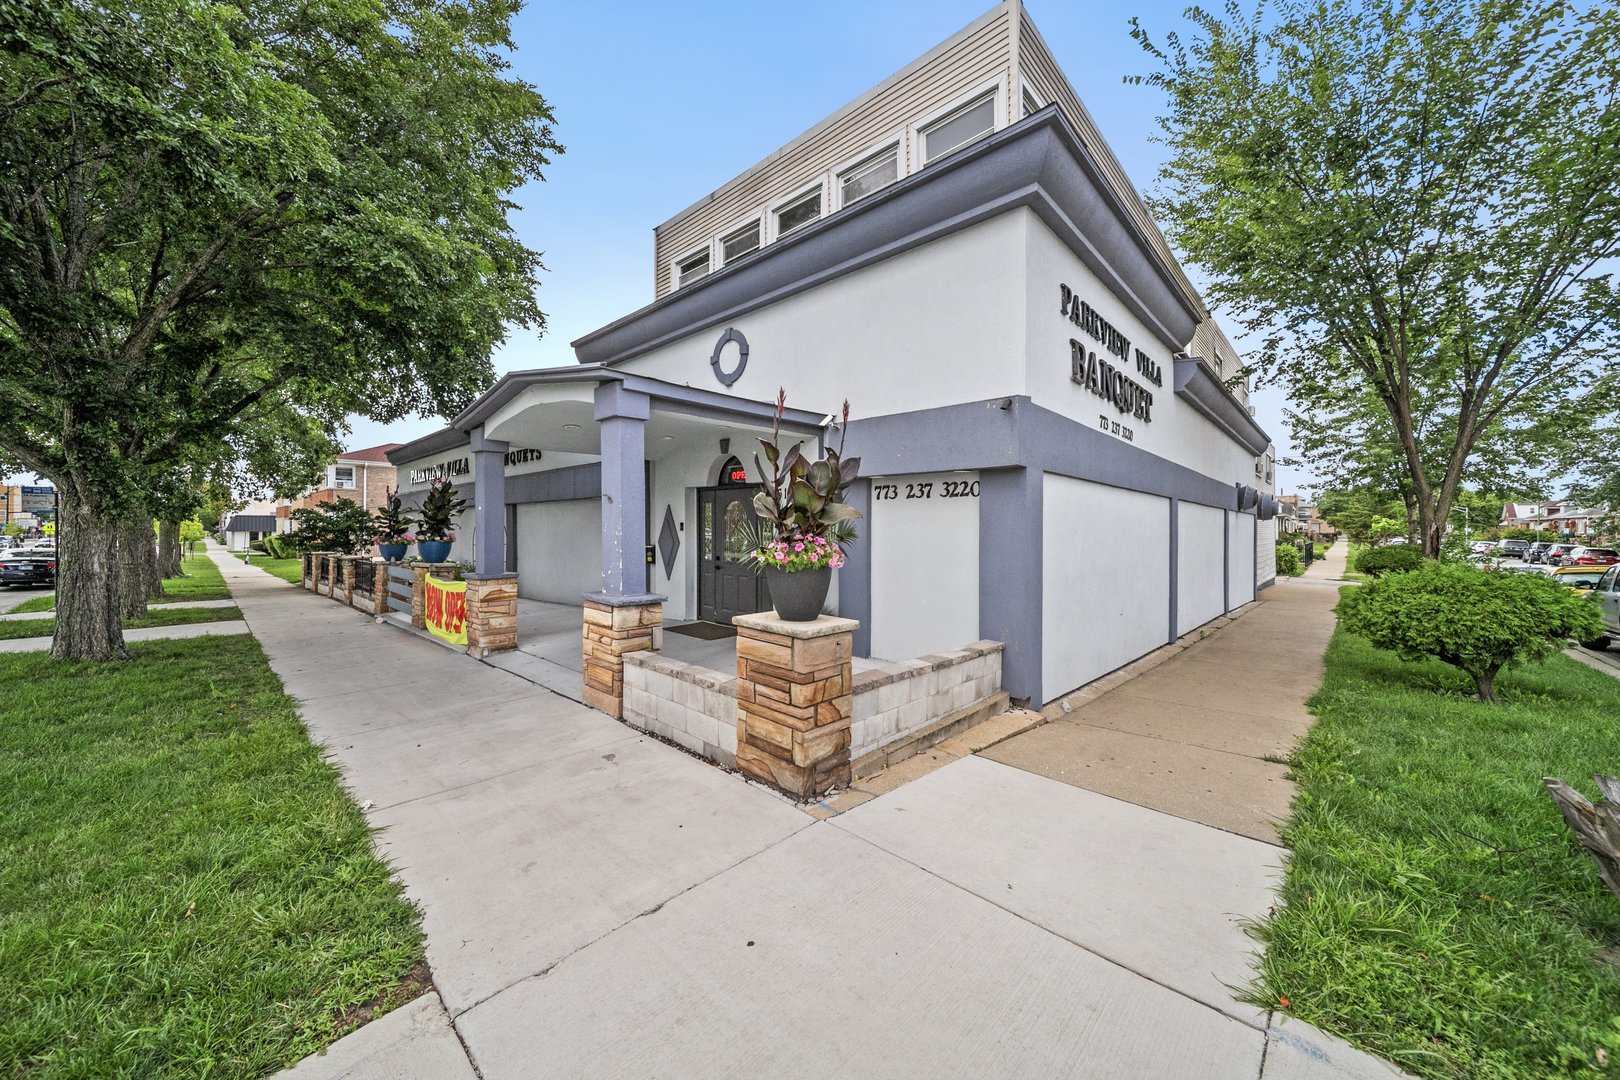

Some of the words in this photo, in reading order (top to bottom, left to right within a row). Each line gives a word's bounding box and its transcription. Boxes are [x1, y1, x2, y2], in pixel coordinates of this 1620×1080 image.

[1060, 283, 1131, 362] PARKVIEW
[1135, 348, 1163, 388] VILLA
[1069, 338, 1154, 424] BANQUET
[1099, 414, 1109, 431] 773
[1111, 420, 1121, 436] 237
[1122, 425, 1134, 442] 3220
[410, 463, 445, 485] PARKVIEW
[447, 457, 470, 477] VILLA
[504, 448, 542, 467] NQUETS
[731, 470, 747, 481] OPE
[874, 484, 899, 501] 773
[905, 482, 934, 500] 237
[939, 480, 980, 498] 3220
